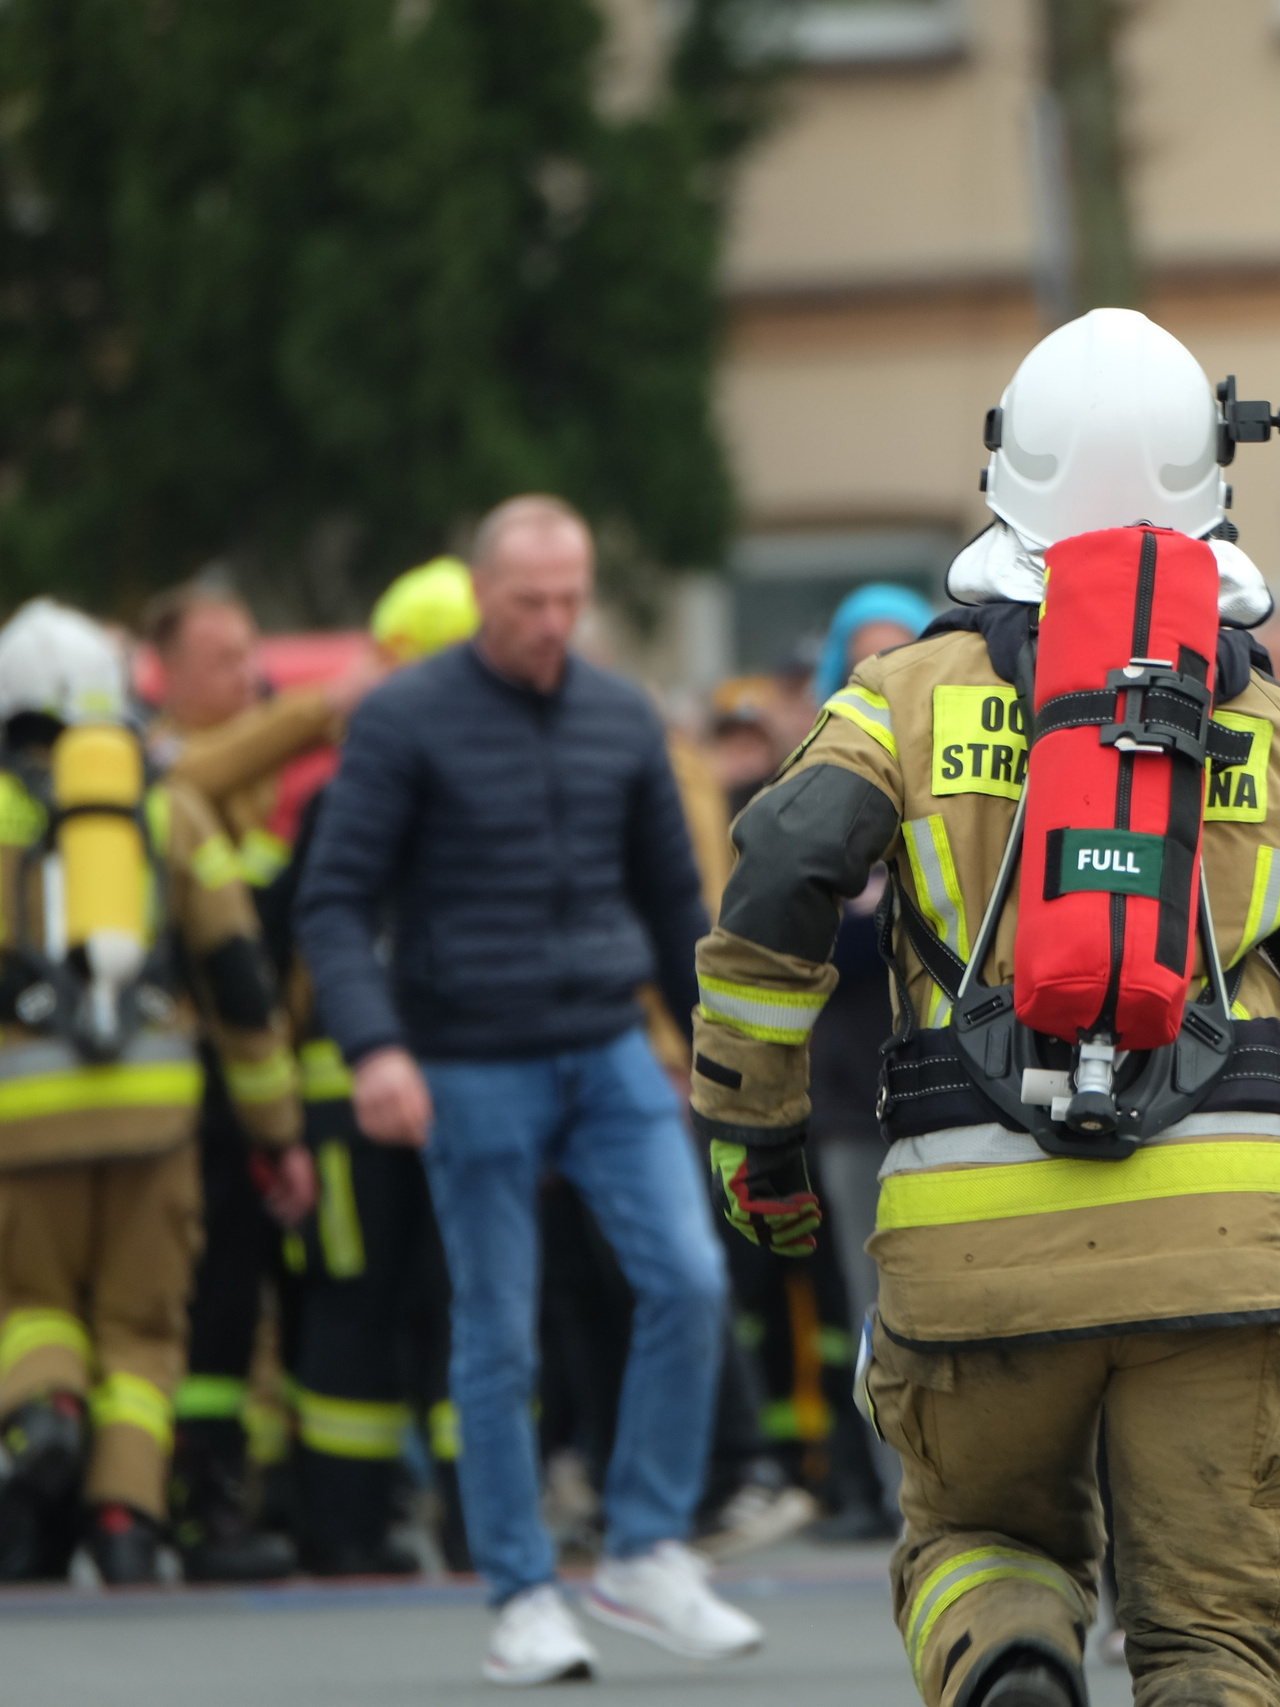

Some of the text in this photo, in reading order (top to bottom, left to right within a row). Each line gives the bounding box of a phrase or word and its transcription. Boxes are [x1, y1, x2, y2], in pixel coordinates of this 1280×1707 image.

[941, 743, 1258, 809] STRA NA
[1077, 849, 1141, 874] FULL
